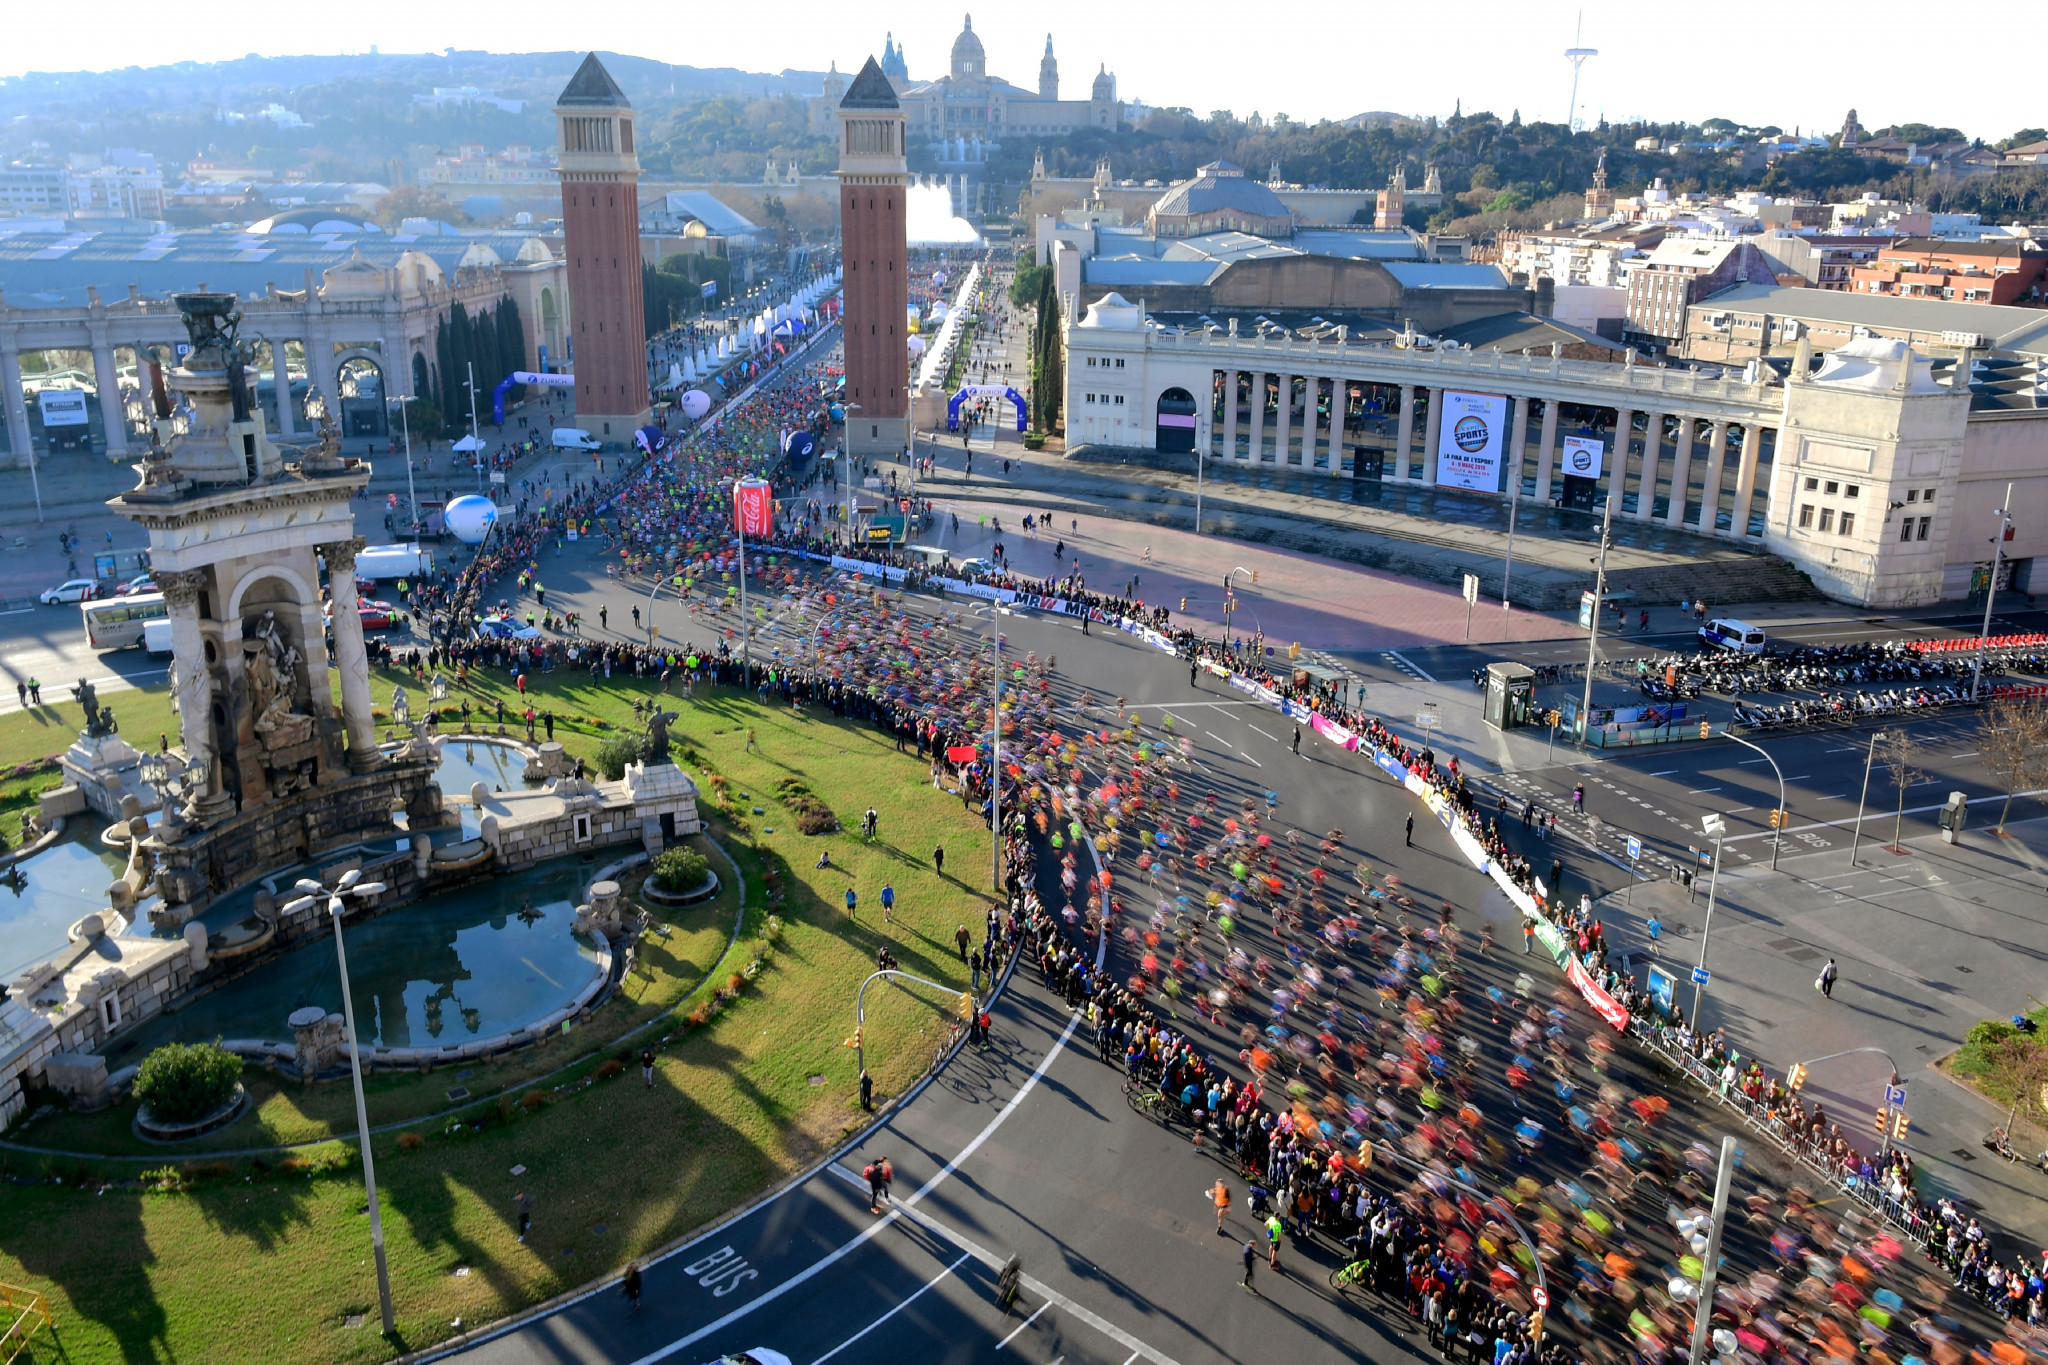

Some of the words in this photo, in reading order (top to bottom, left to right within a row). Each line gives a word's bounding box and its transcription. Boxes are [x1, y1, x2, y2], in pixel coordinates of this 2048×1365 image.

[1454, 429, 1488, 441] SPORTS
[1463, 455, 1470, 463] DE
[838, 561, 866, 573] GARMIN
[970, 588, 1000, 600] GARMIN
[1014, 592, 1057, 610] MRW
[1762, 838, 1802, 854] TAXI
[1795, 833, 1832, 848] BUS
[1693, 971, 1708, 981] TAXI
[683, 1244, 759, 1297] BUS
